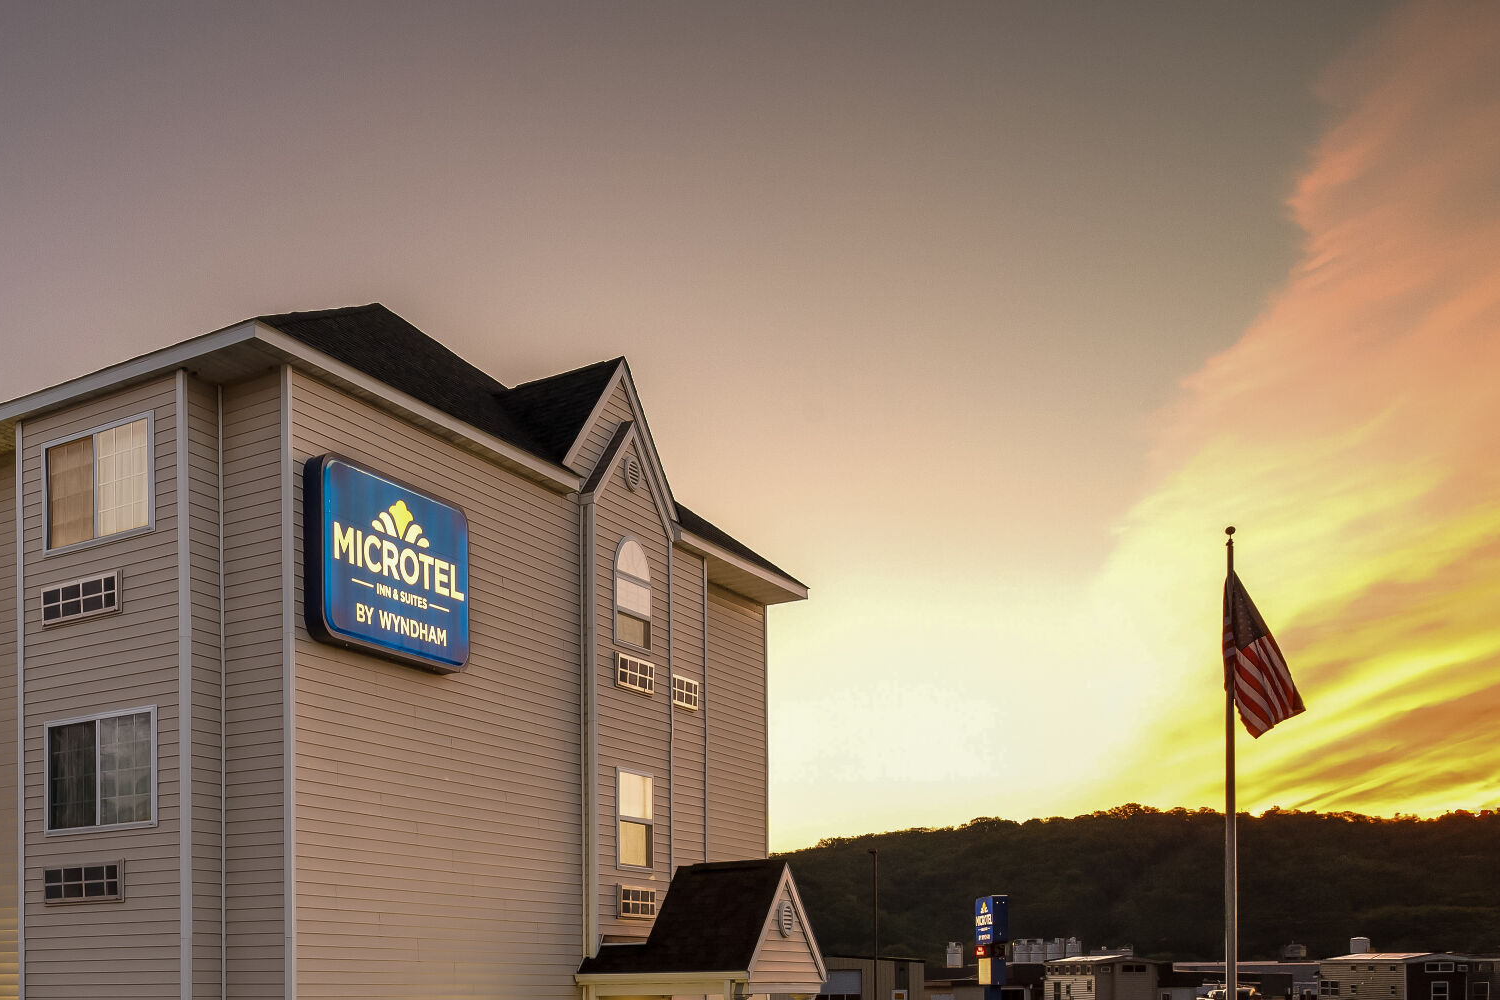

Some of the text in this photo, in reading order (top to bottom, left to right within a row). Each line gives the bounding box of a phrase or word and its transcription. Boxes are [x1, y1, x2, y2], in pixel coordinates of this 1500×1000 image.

[333, 521, 465, 601] MICROTEL
[376, 583, 427, 609] INN & SUITES
[356, 603, 447, 646] BY WYNDHAM
